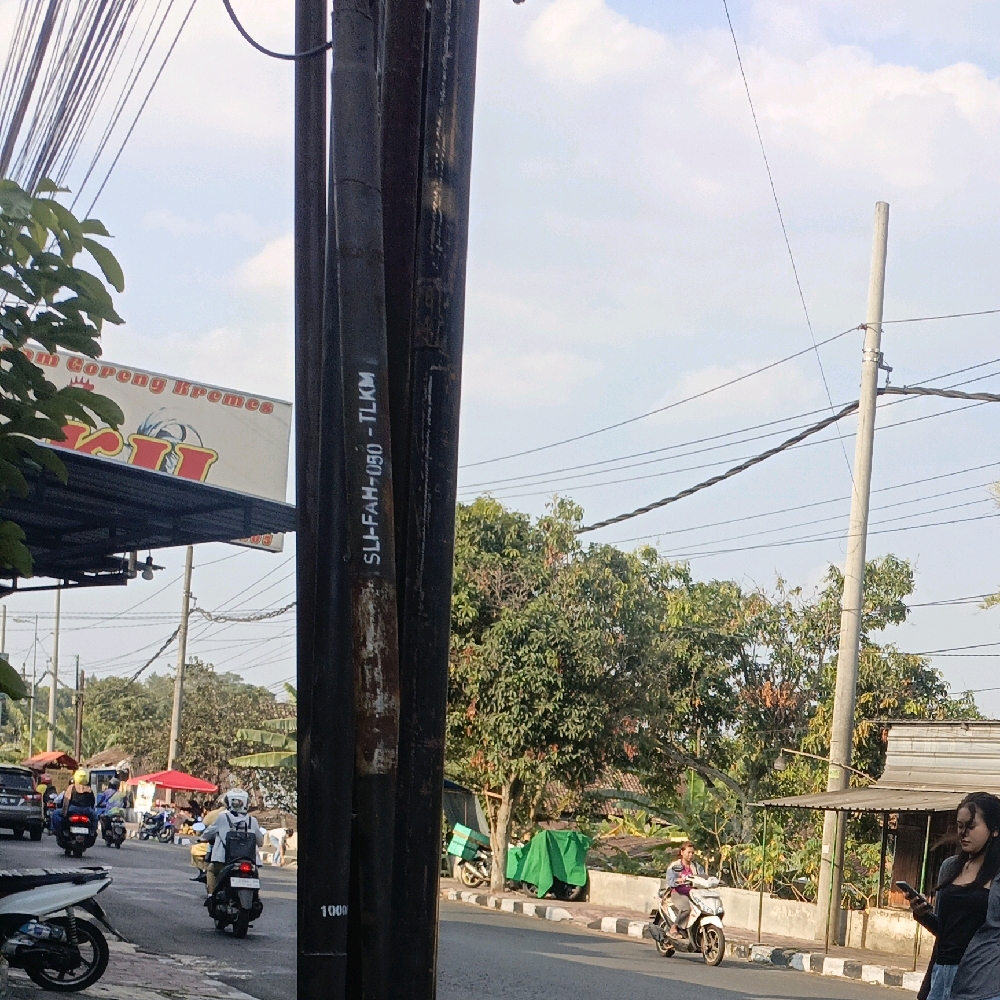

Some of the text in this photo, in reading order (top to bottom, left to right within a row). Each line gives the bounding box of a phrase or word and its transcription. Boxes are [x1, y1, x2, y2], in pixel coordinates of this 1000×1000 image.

[66, 355, 168, 395] Goreng
[172, 379, 275, 415] Kremes
[358, 371, 377, 423] TLKM
